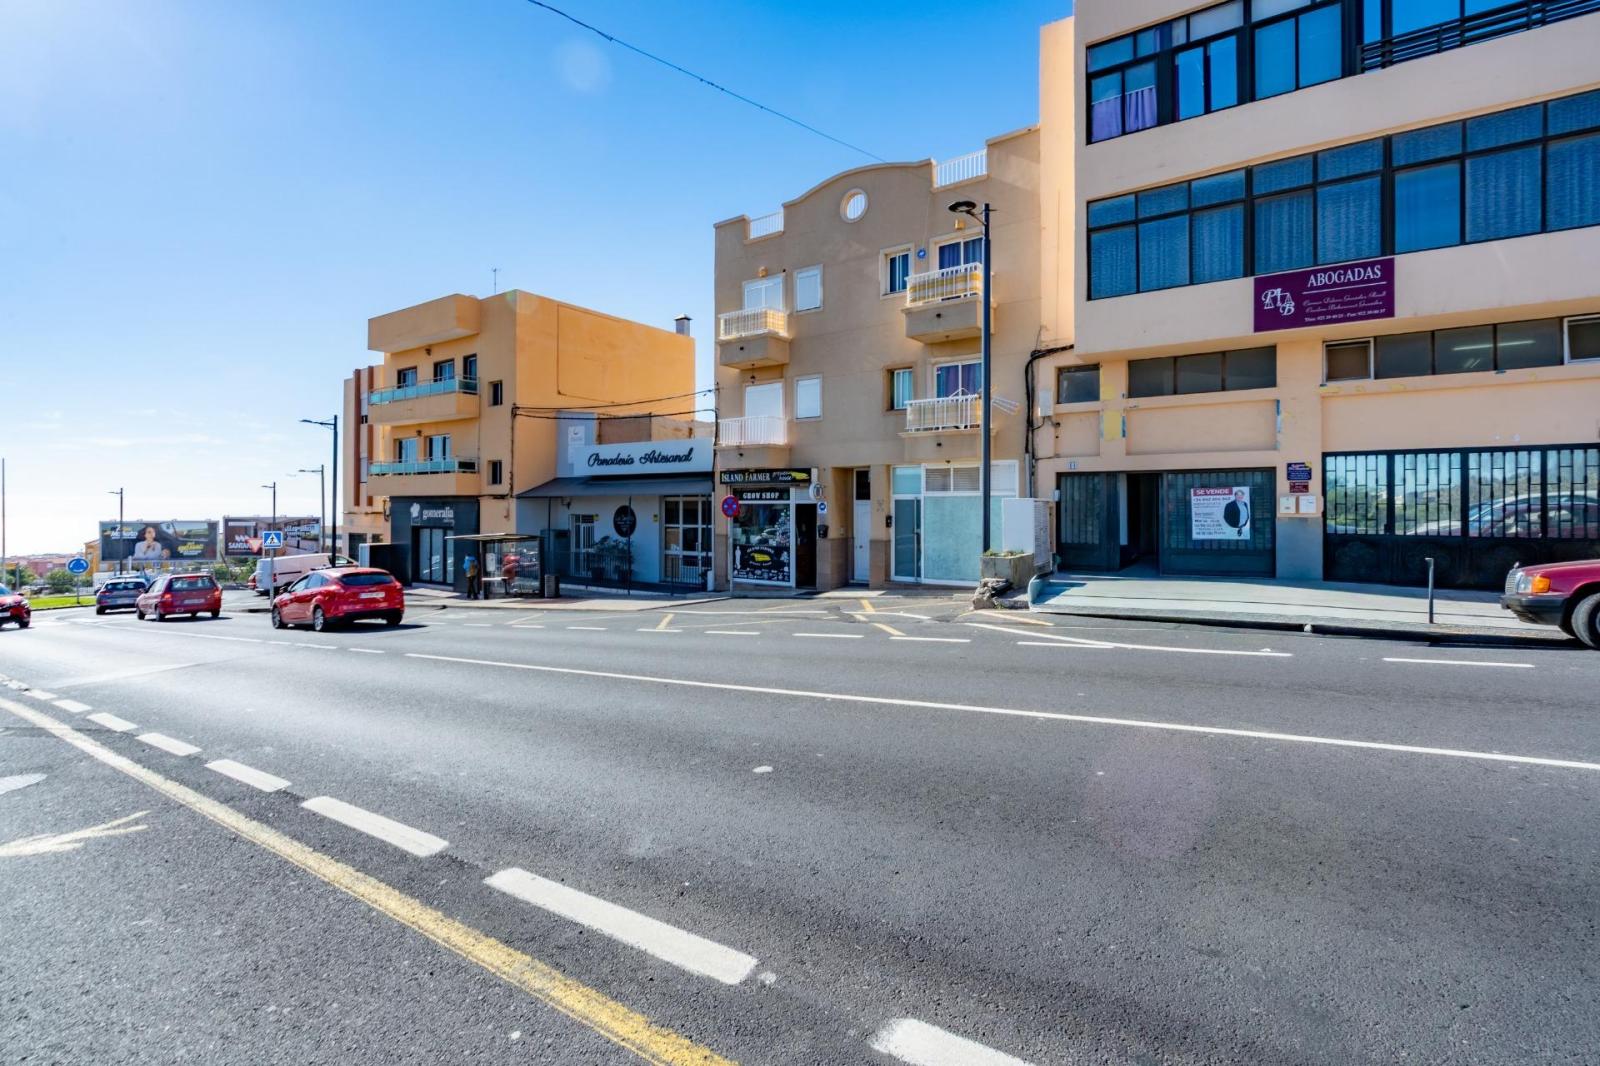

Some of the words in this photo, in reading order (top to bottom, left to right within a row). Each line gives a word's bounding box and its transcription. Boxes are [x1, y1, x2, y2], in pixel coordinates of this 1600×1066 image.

[1307, 265, 1381, 288] ABOGADAS
[639, 447, 694, 464] Artesanal
[721, 473, 744, 482] ISLAND
[745, 472, 771, 481] FARMER
